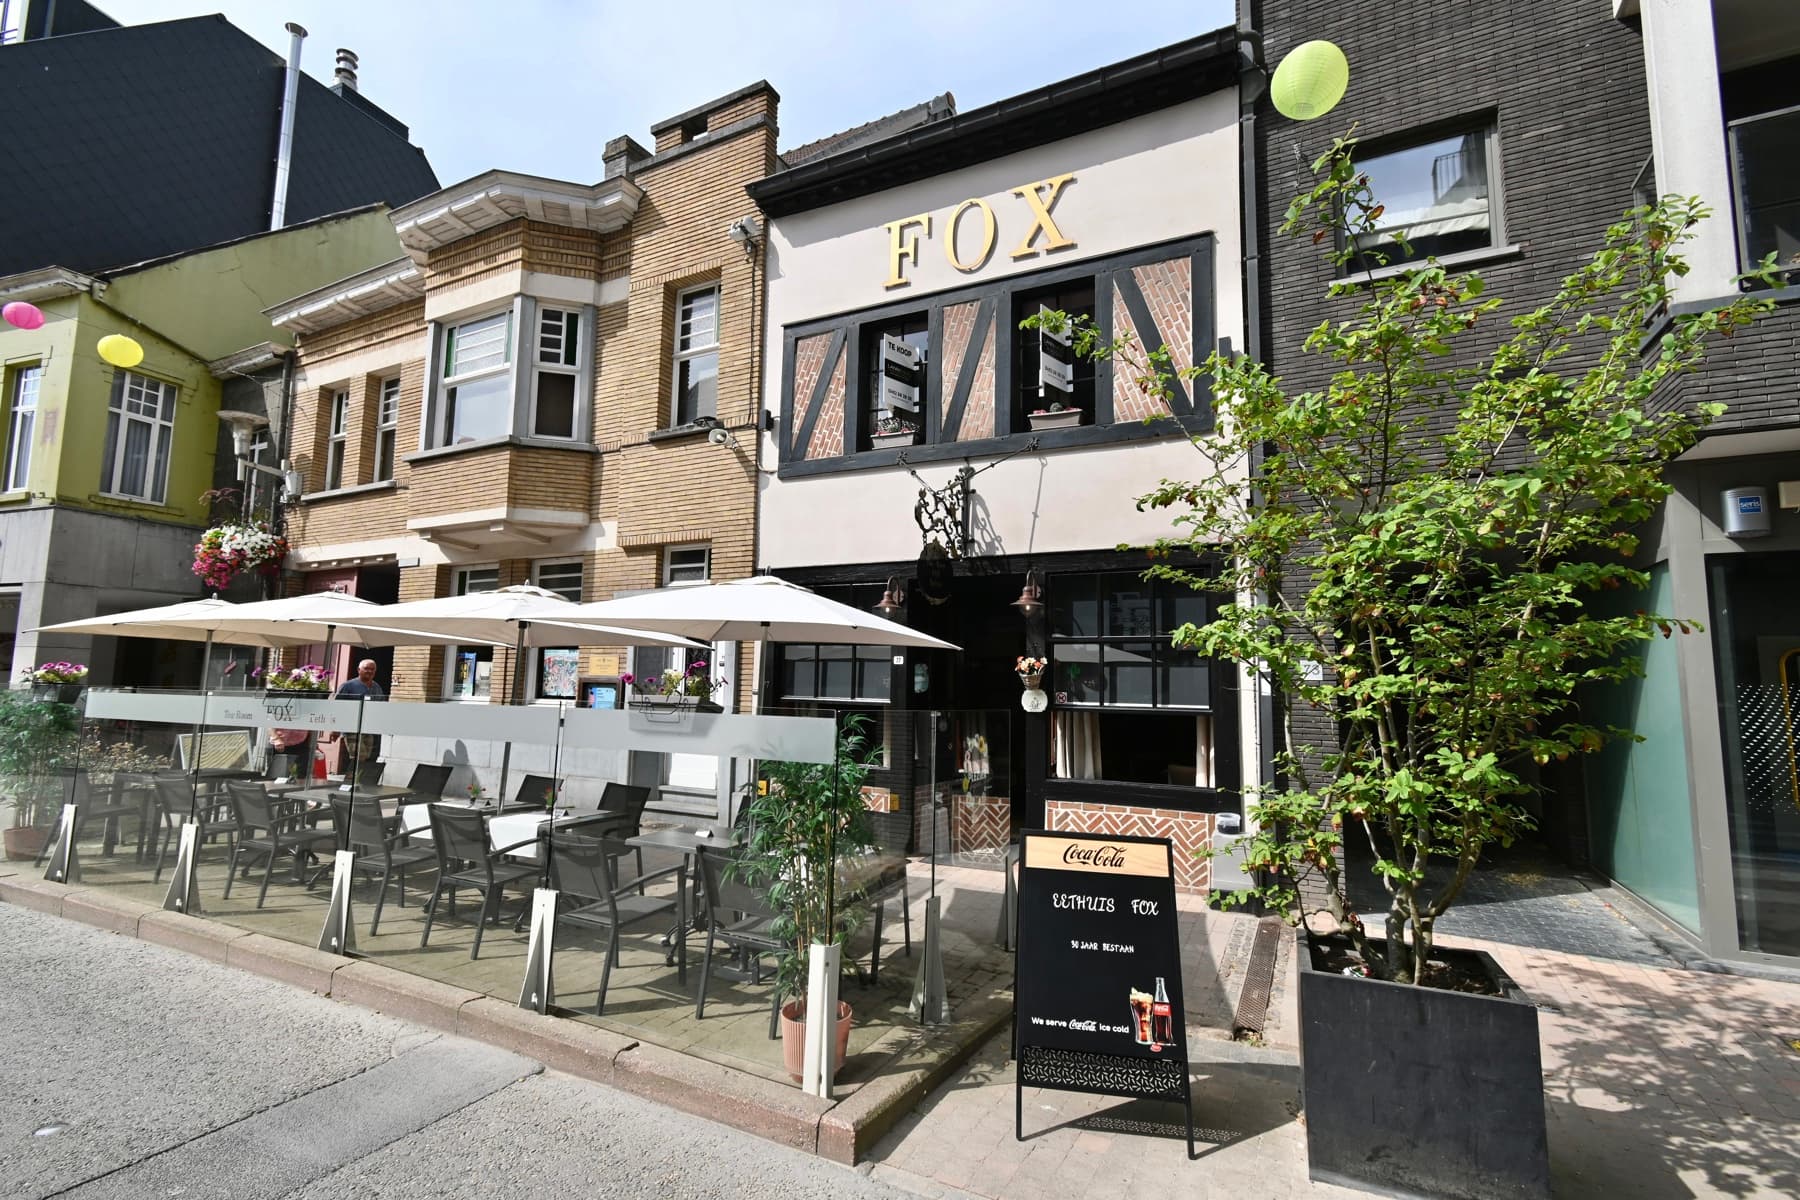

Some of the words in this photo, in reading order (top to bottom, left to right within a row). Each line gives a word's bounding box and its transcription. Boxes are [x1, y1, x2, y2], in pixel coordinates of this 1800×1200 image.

[882, 173, 1075, 288] FOX
[888, 341, 896, 350] TE
[897, 345, 912, 356] KOOP
[1304, 664, 1320, 675] 73
[1063, 843, 1127, 868] Coca-Cola
[1052, 892, 1115, 913] EETHUIS
[1131, 898, 1159, 916] FOX
[1080, 941, 1098, 951] JAAR
[1102, 943, 1134, 953] BESTAAN
[1031, 1016, 1044, 1025] We
[1045, 1018, 1067, 1028] serve
[1099, 1023, 1111, 1032] ice
[1112, 1025, 1129, 1034] cold
